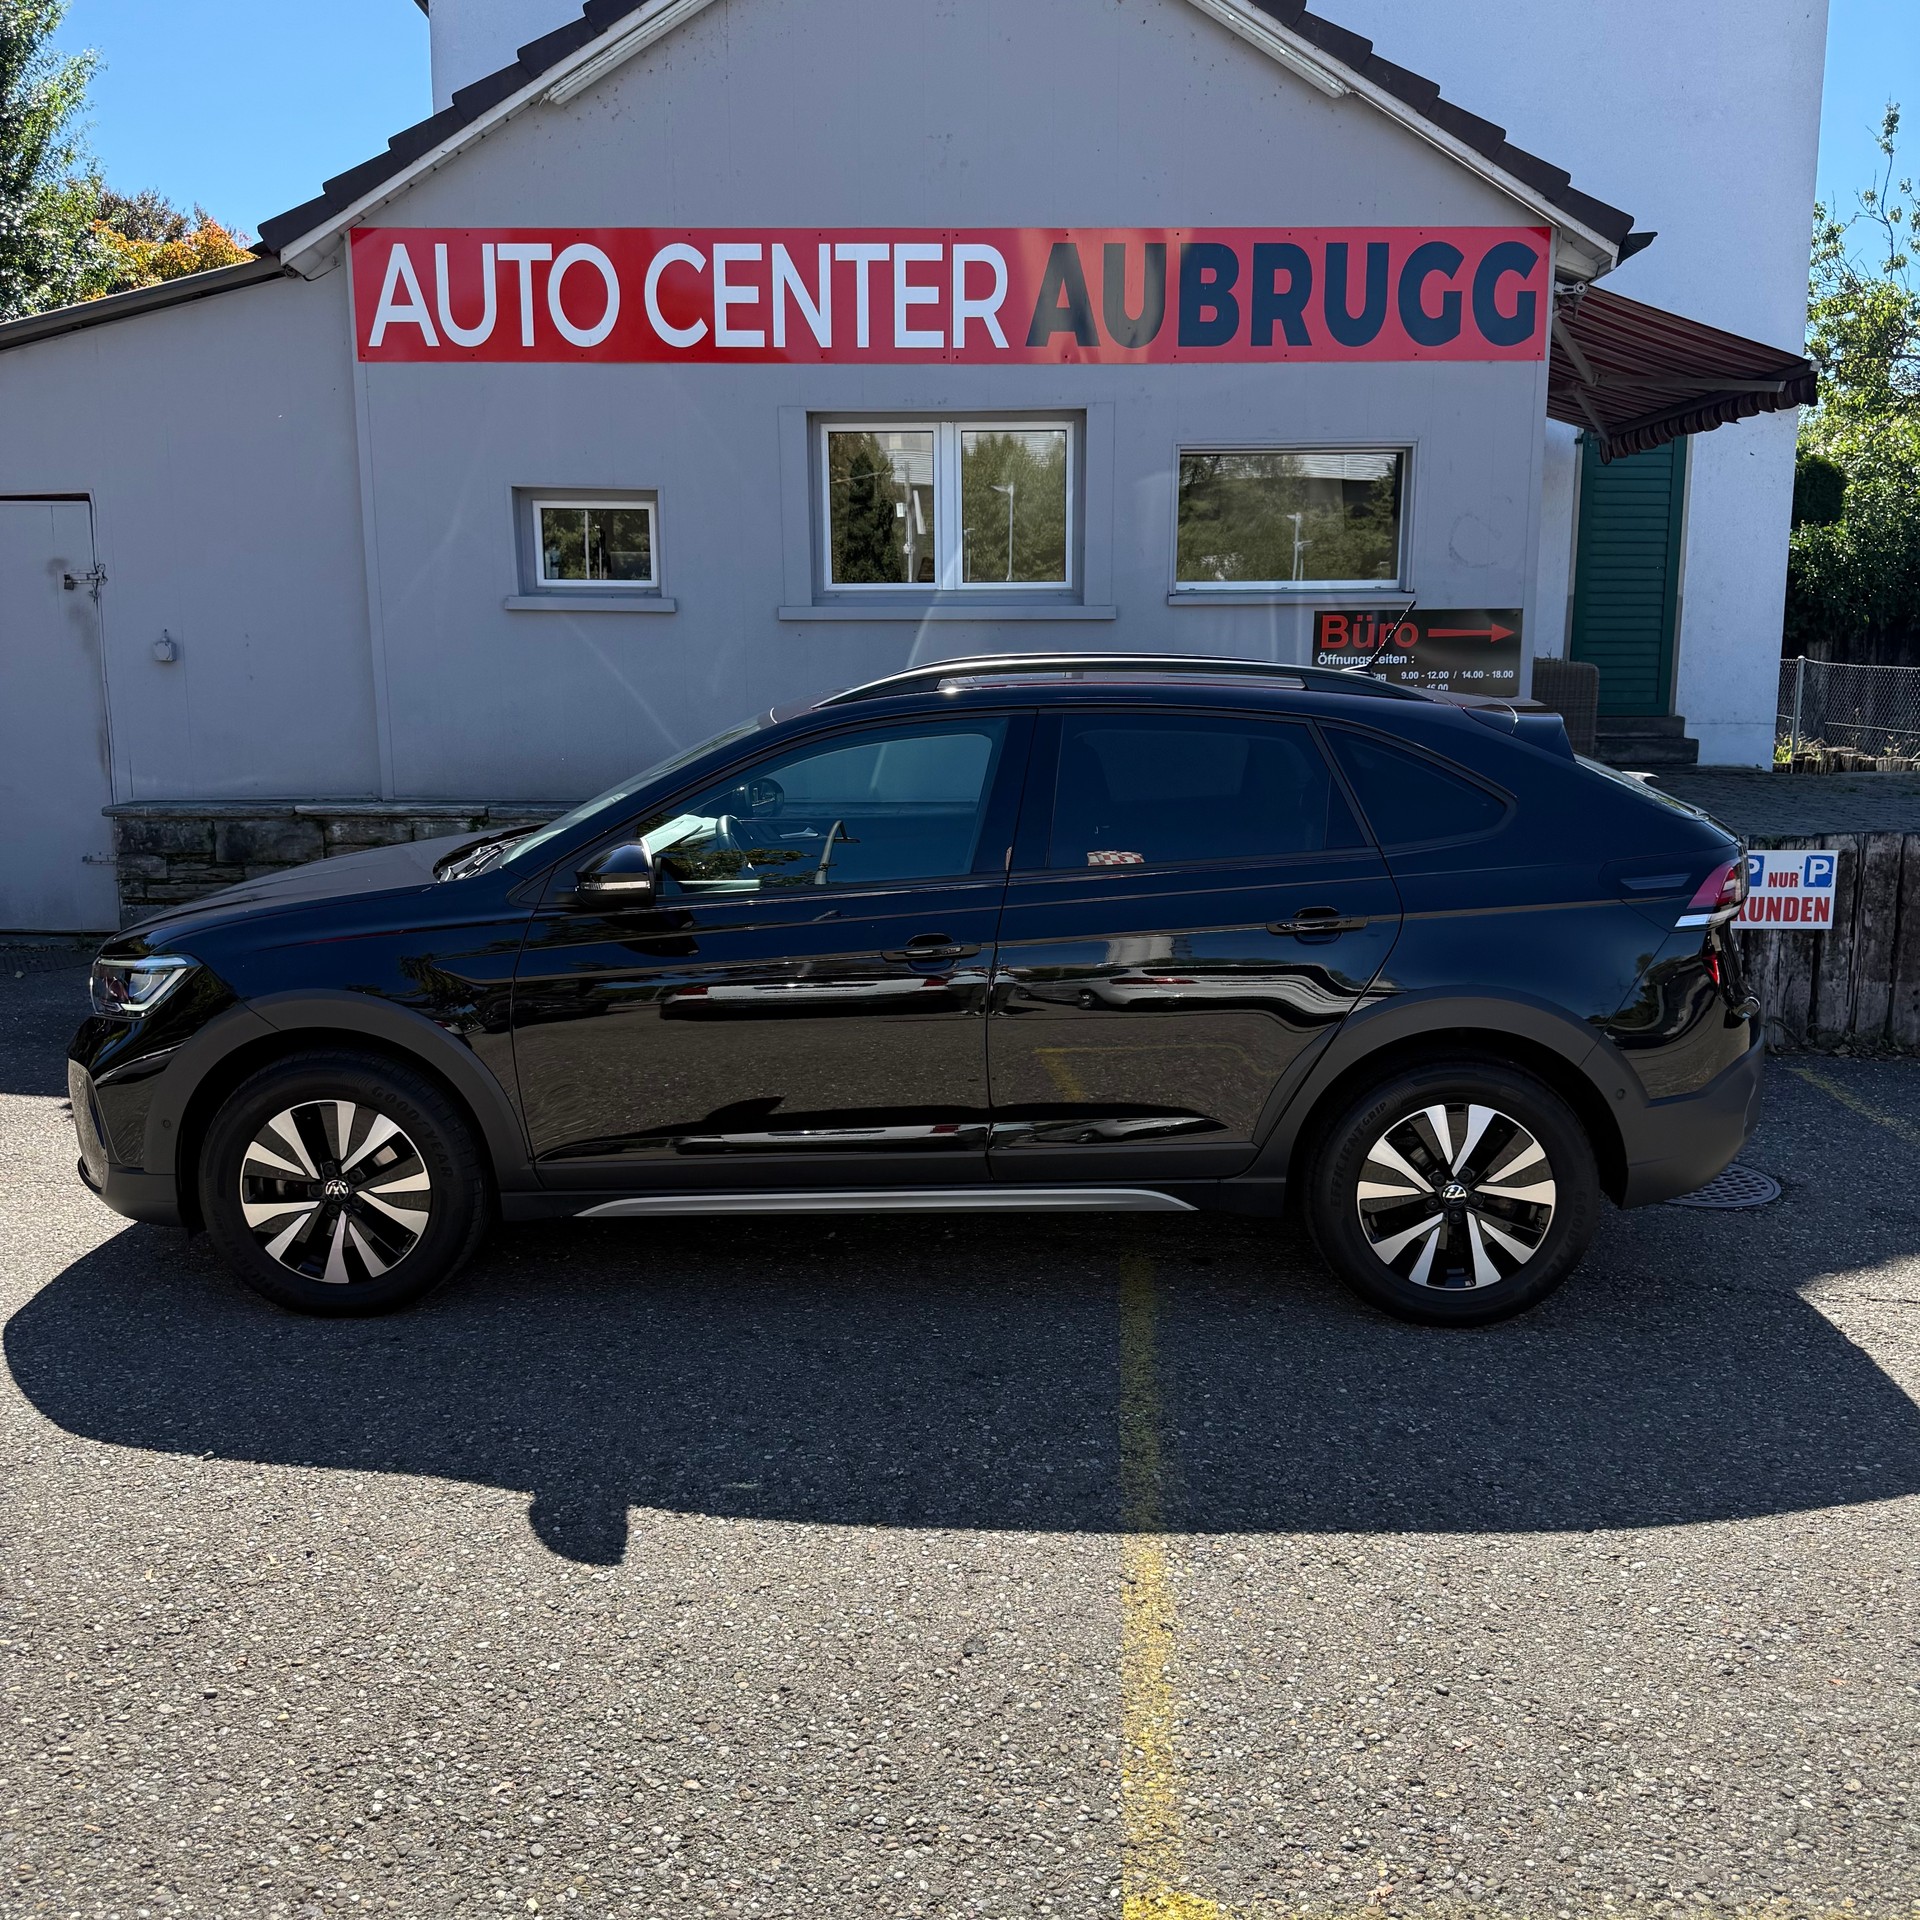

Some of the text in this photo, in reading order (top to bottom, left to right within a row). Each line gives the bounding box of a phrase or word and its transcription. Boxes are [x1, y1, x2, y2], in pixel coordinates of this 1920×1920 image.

[368, 241, 1540, 349] AUTO CENTER AUBRUGG
[1321, 614, 1419, 649] Büro
[1318, 652, 1407, 667] Öffnungseiten
[1401, 671, 1419, 680] 9.00
[1427, 671, 1449, 679] 12.00
[1462, 670, 1484, 679] 14.00
[1492, 670, 1514, 679] 18.00
[1768, 872, 1799, 888] NUR
[1808, 859, 1830, 883] P
